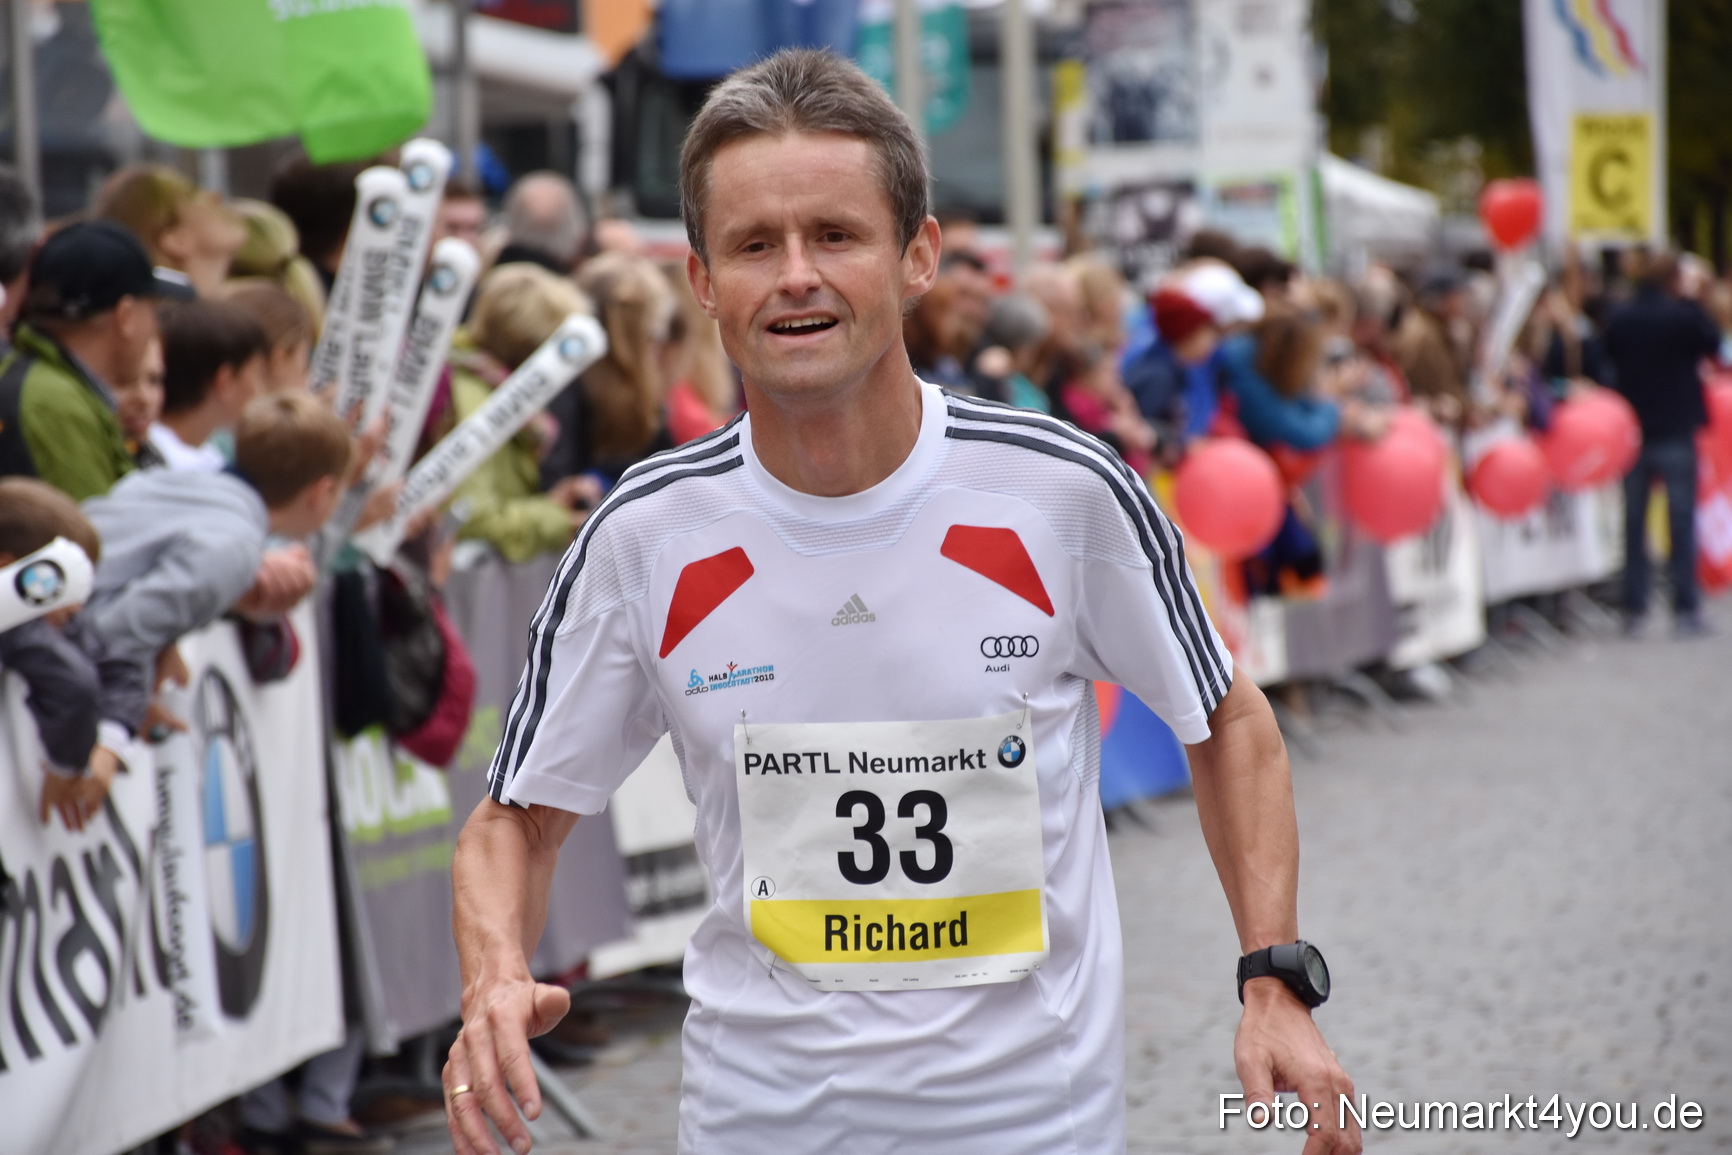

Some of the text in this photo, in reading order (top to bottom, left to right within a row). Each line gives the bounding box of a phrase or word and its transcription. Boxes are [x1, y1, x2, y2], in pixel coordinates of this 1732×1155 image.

[1587, 146, 1633, 212] C
[831, 611, 876, 627] adidas
[985, 664, 1010, 673] Audi
[684, 686, 709, 697] odlo
[743, 748, 987, 776] PARTL Neumarkt
[835, 789, 953, 885] 33
[757, 879, 769, 896] A
[824, 910, 968, 952] Richard
